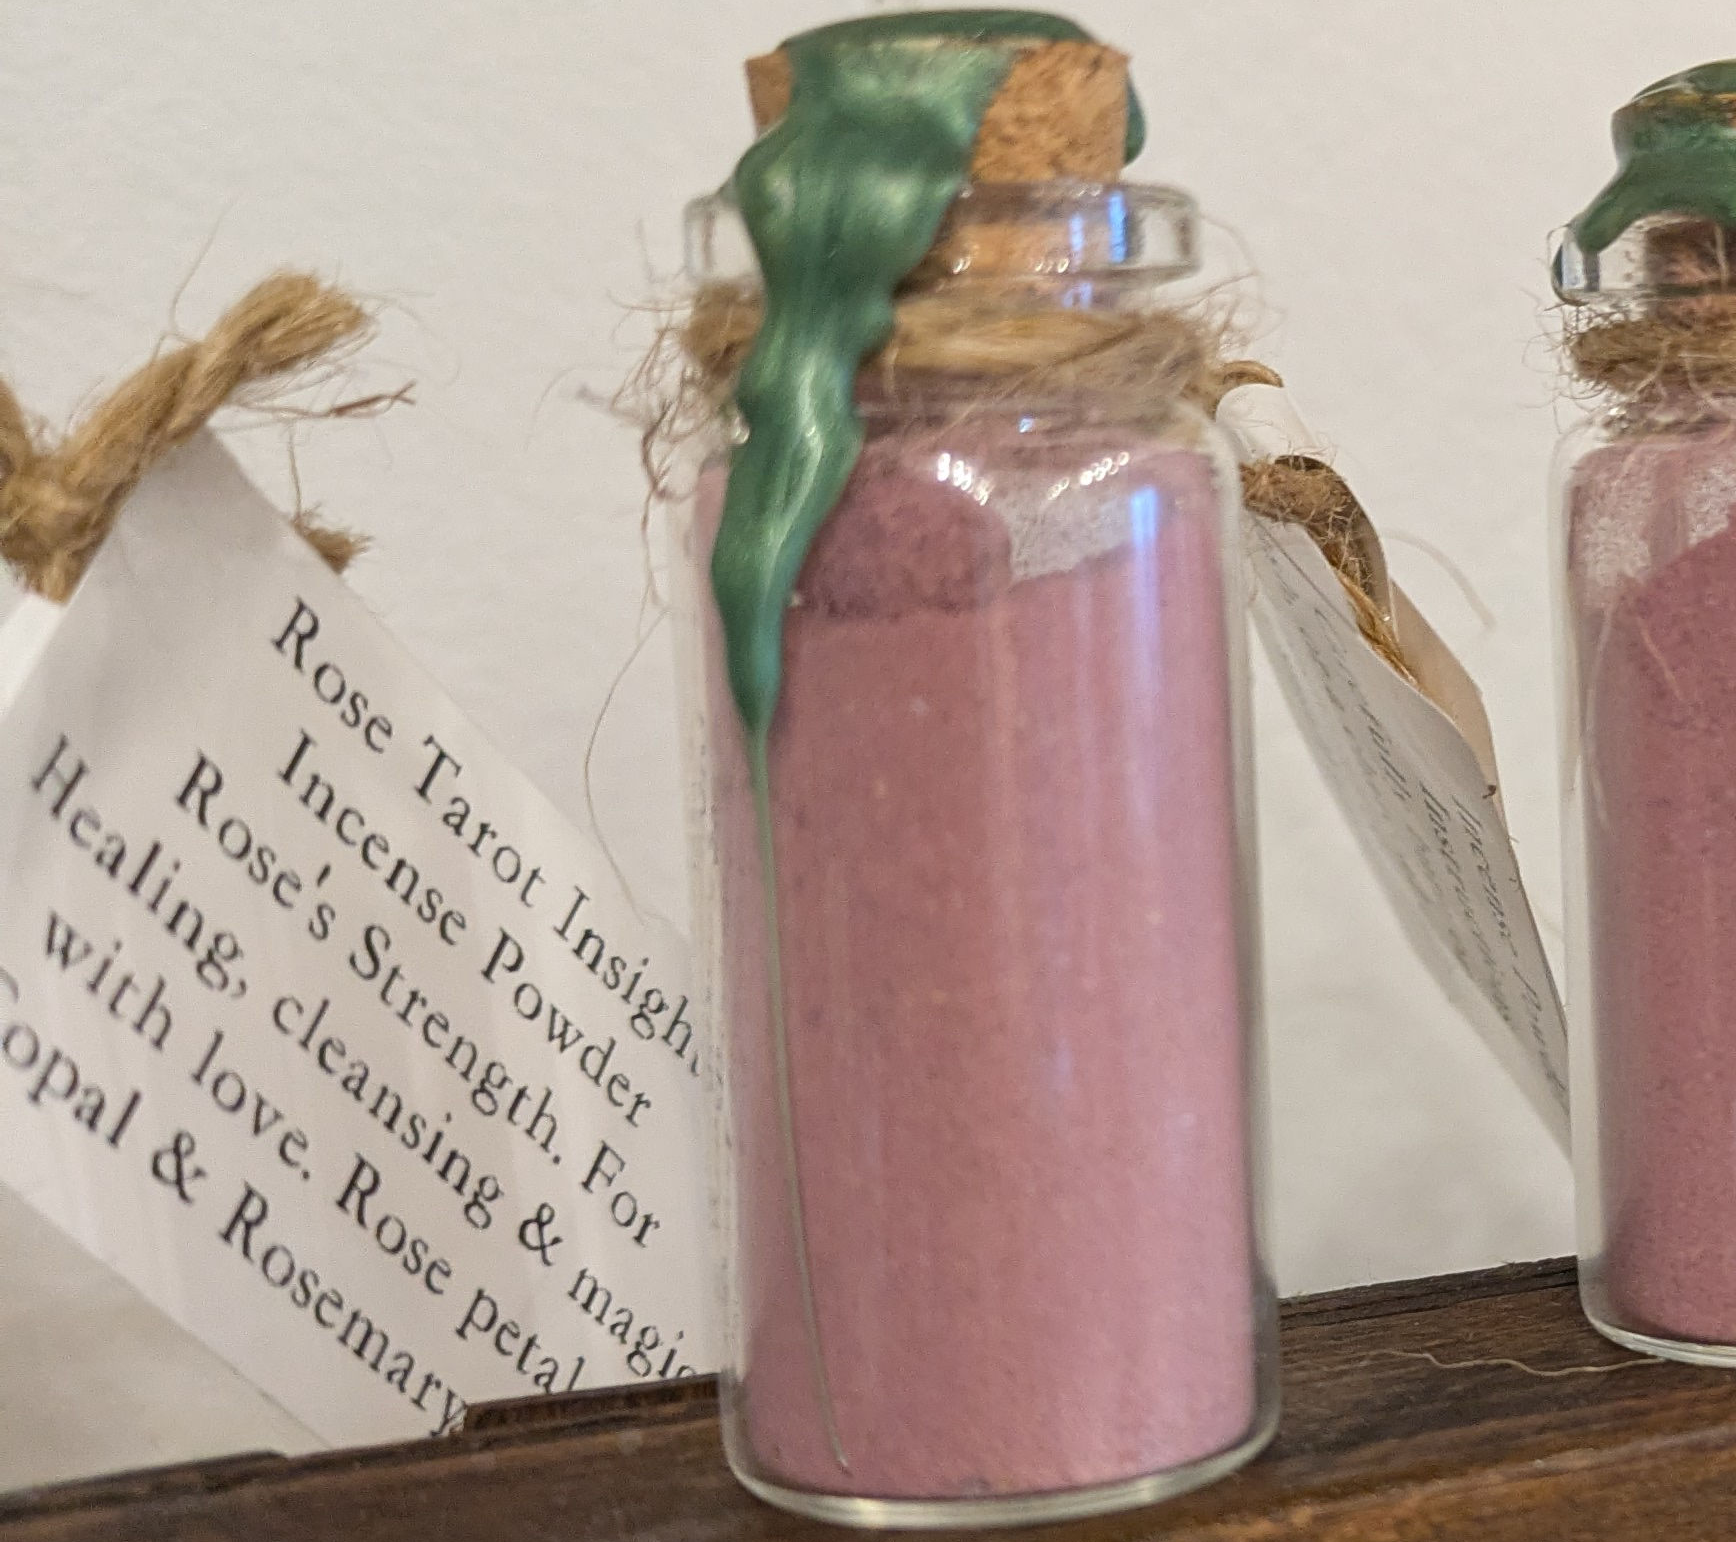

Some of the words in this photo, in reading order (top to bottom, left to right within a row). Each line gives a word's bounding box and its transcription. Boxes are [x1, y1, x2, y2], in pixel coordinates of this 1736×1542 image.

[271, 596, 393, 754] Rose
[414, 734, 545, 908] Tarot
[277, 728, 466, 946] Incense
[480, 927, 651, 1128] Powder
[0, 967, 141, 1149] opal
[151, 1130, 206, 1206] &
[30, 733, 246, 997] Healing,
[272, 996, 504, 1230] cleansing
[517, 1202, 563, 1267] &
[45, 911, 172, 1053] with
[191, 1029, 310, 1181] love.
[335, 1153, 452, 1295] Rose
[175, 749, 336, 941] Rose's
[349, 924, 561, 1165] Strength.
[580, 1140, 660, 1248] For
